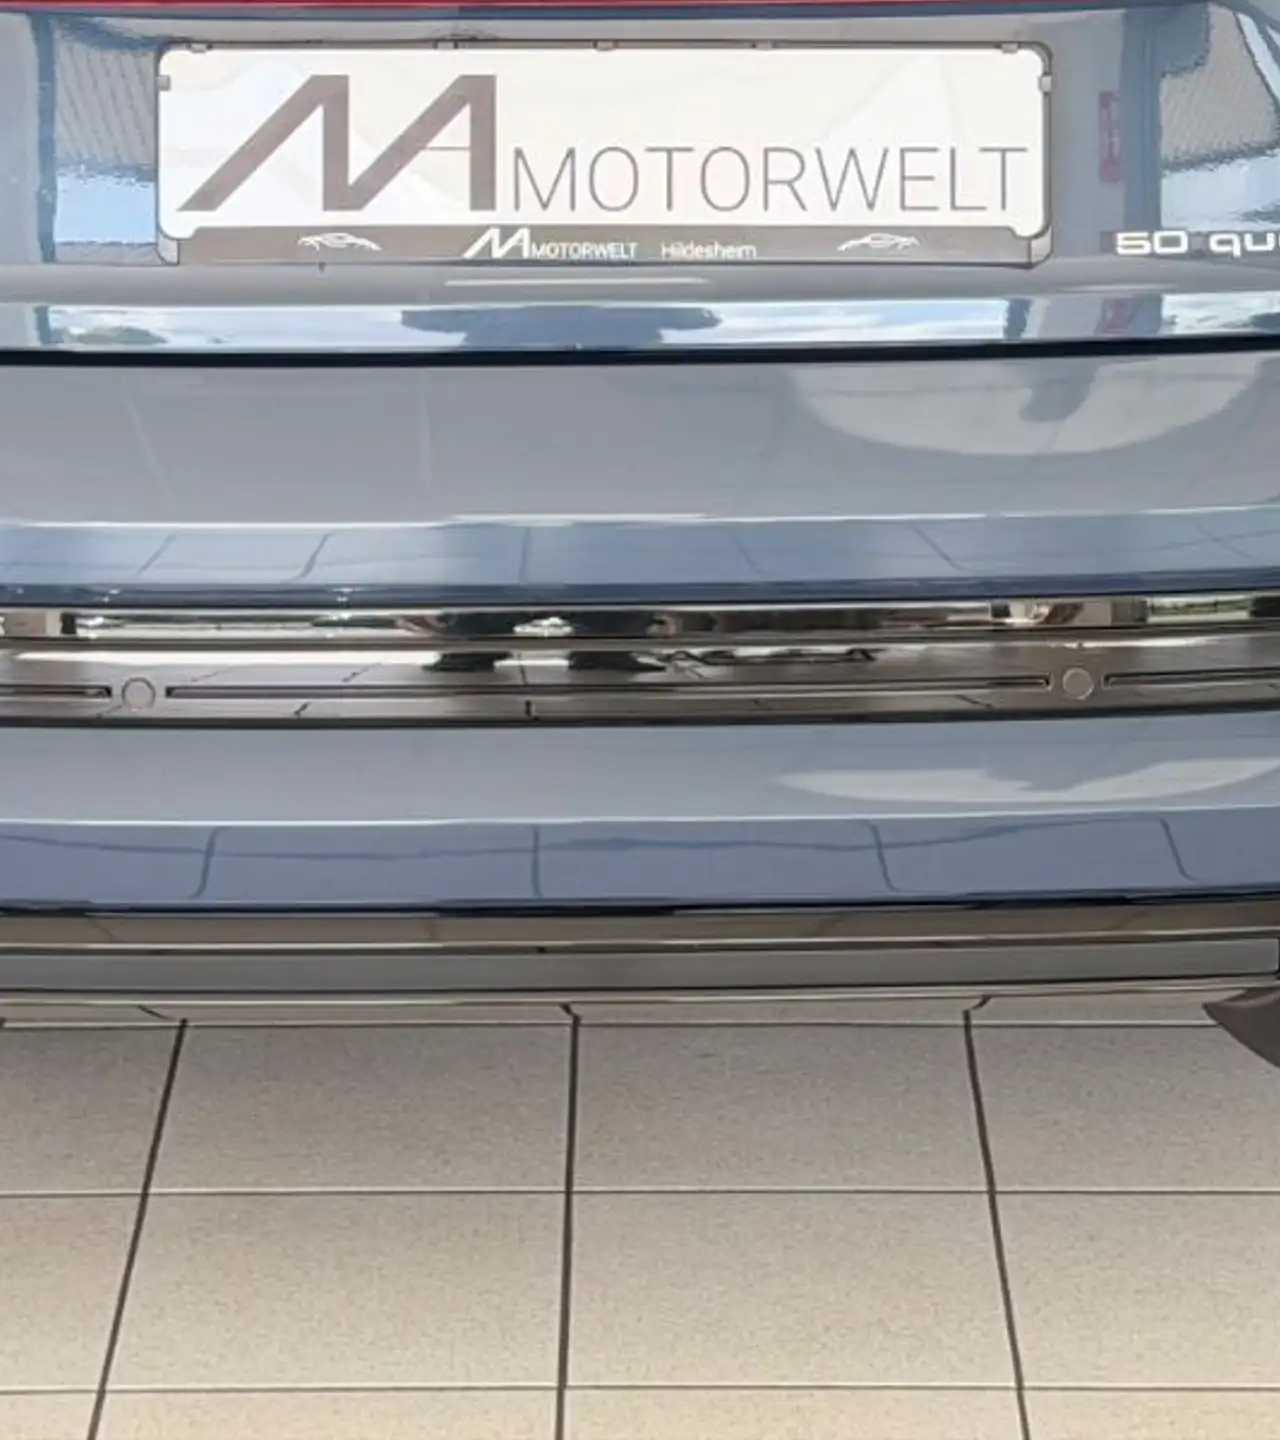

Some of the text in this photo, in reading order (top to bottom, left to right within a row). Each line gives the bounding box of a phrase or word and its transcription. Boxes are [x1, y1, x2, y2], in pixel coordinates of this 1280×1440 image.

[513, 145, 1028, 212] MOTORWELT
[532, 242, 638, 260] MOTORWELT
[660, 240, 757, 260] Hildesheim
[1115, 230, 1189, 255] 50
